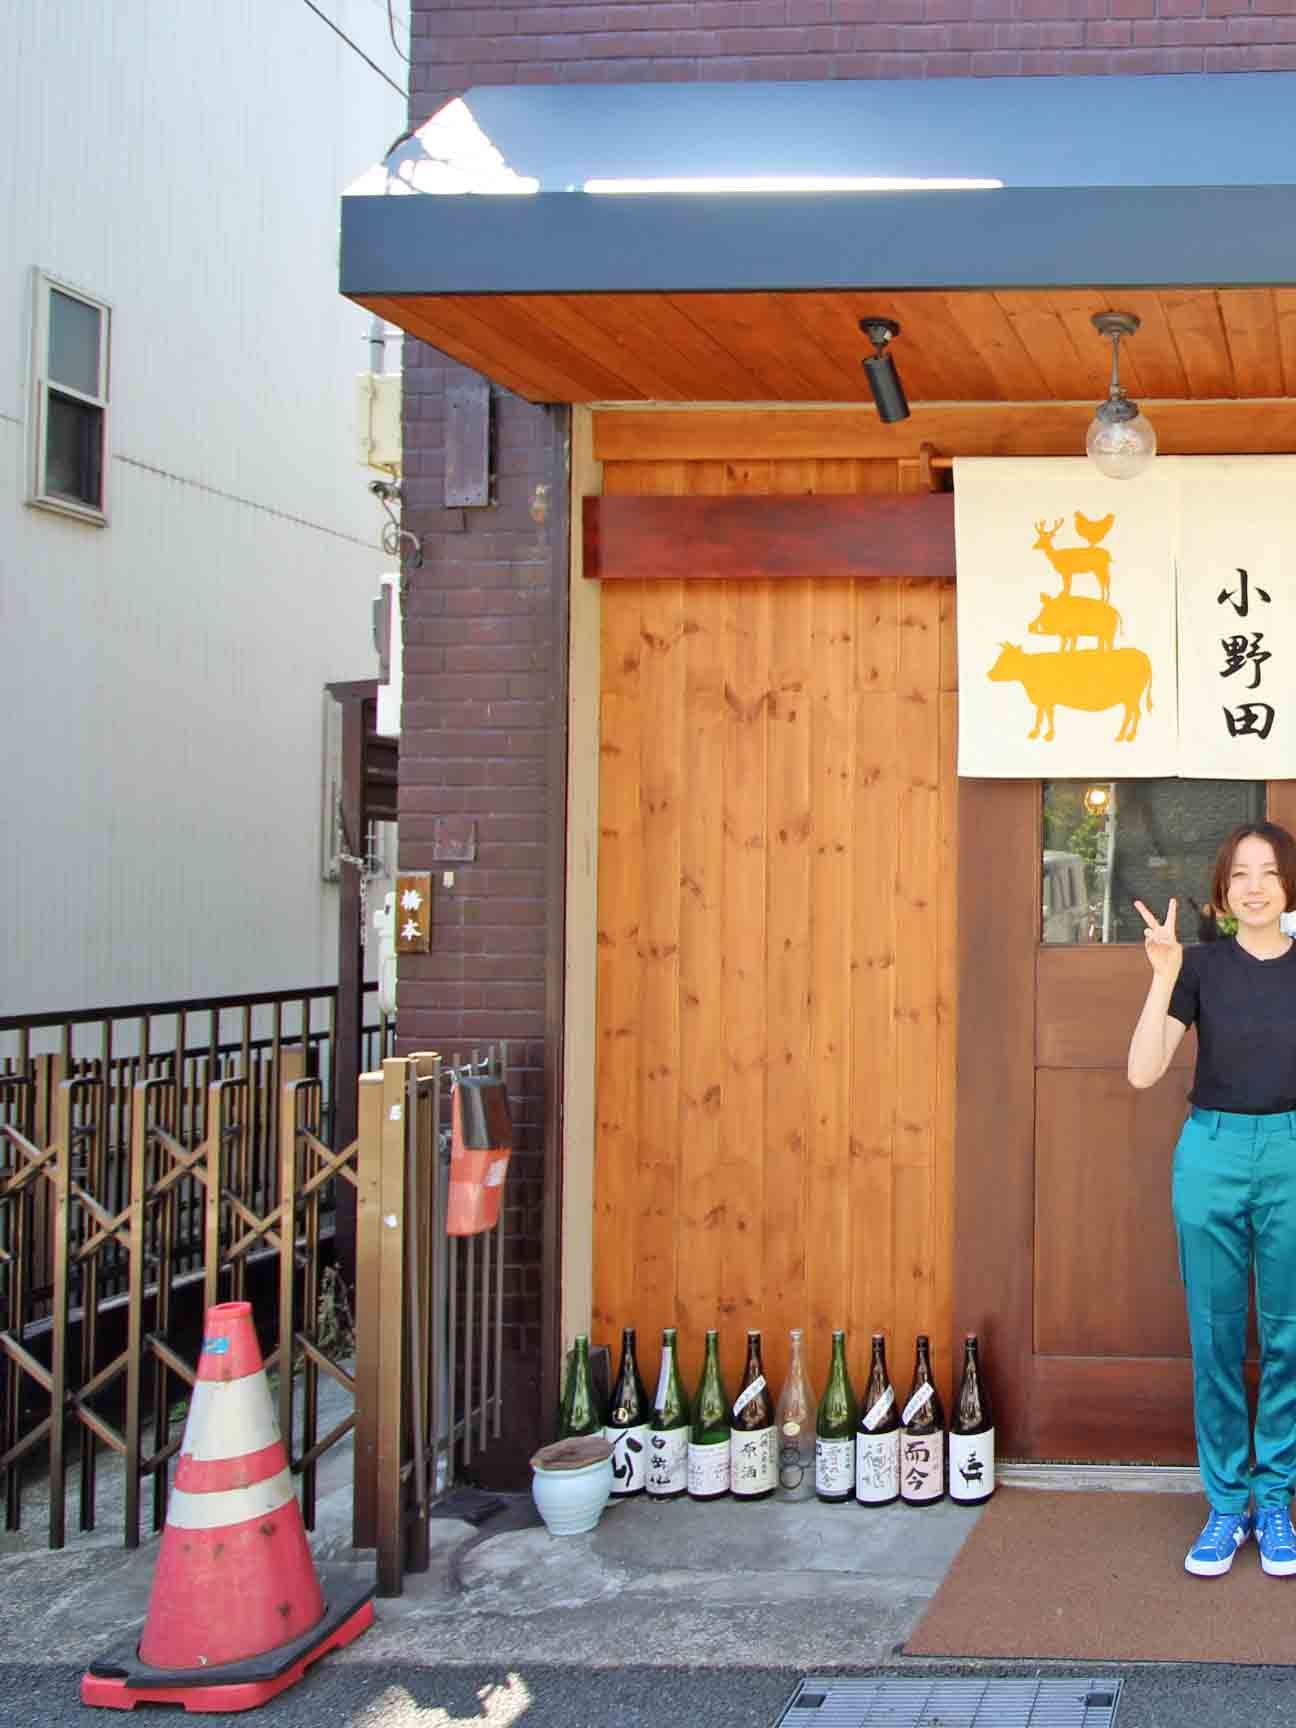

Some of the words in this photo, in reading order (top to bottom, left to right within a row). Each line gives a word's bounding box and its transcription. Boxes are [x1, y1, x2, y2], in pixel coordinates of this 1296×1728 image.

[1217, 568, 1275, 739] 小野田
[905, 1441, 930, 1490] 而今
